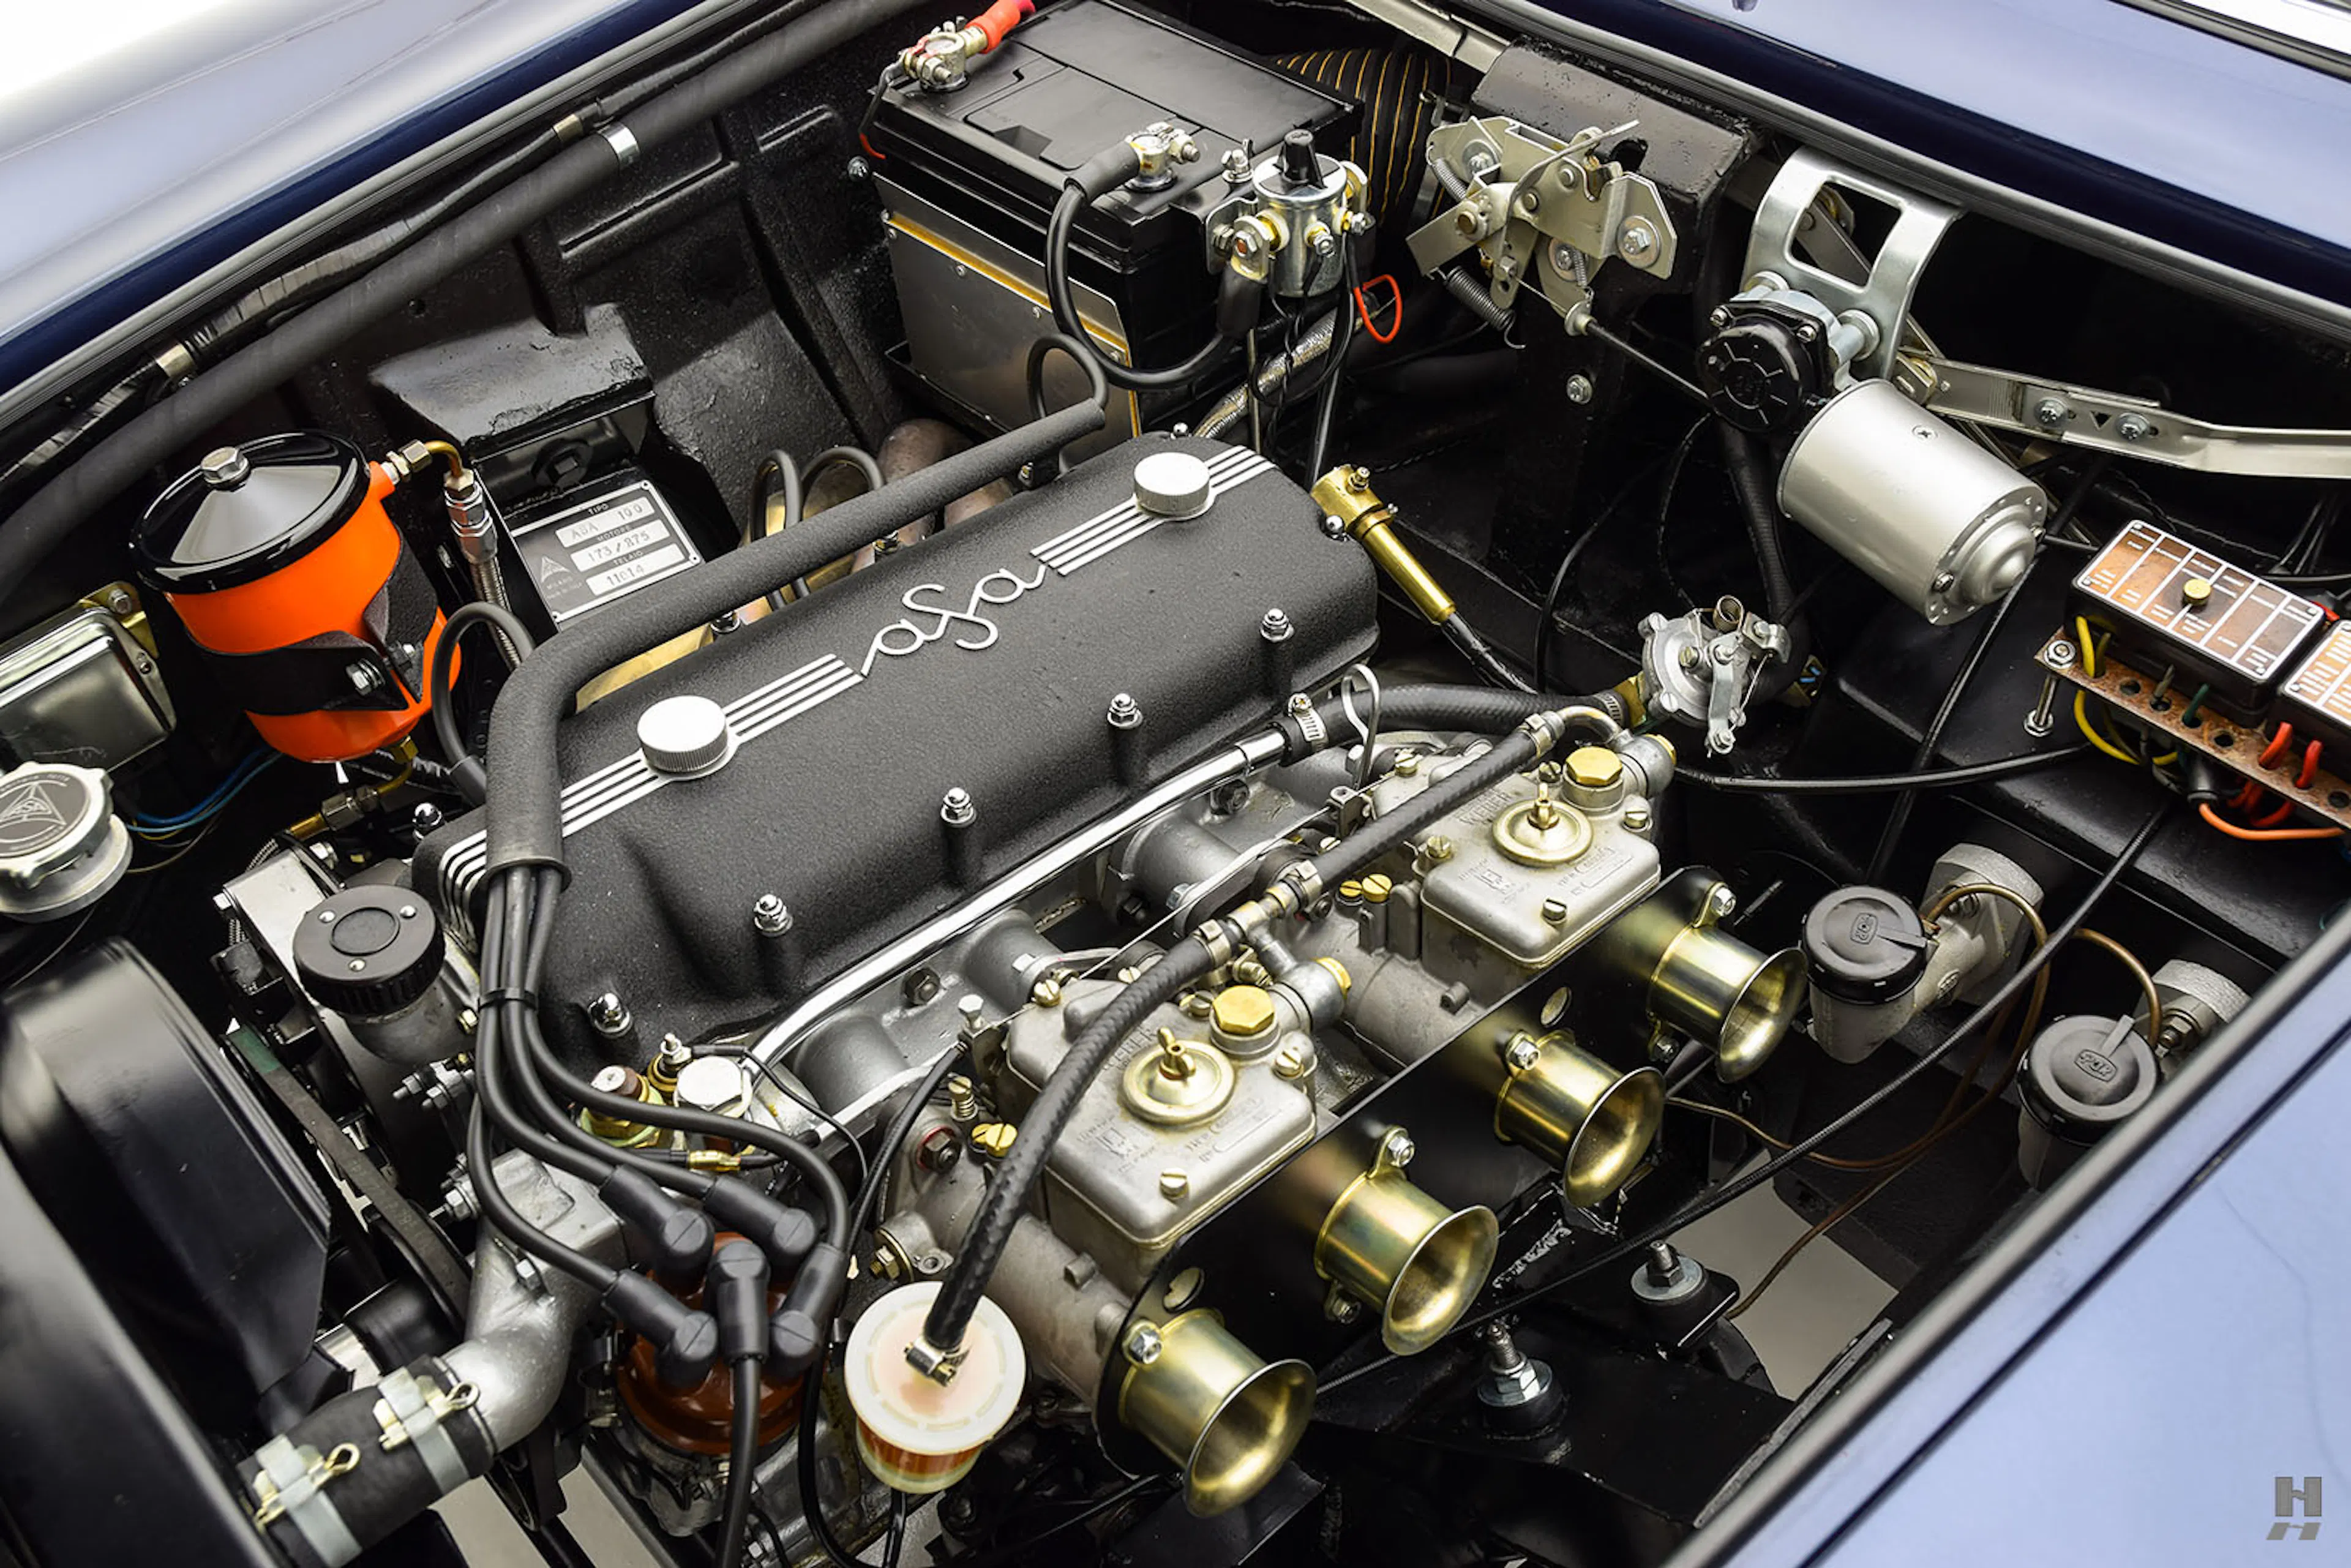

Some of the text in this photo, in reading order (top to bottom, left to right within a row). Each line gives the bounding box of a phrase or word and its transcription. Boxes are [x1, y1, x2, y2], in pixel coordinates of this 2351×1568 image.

[588, 503, 609, 515] TIPO
[571, 504, 643, 539] ASA 100
[597, 525, 632, 542] MOTORE
[613, 551, 643, 565] TELAIO
